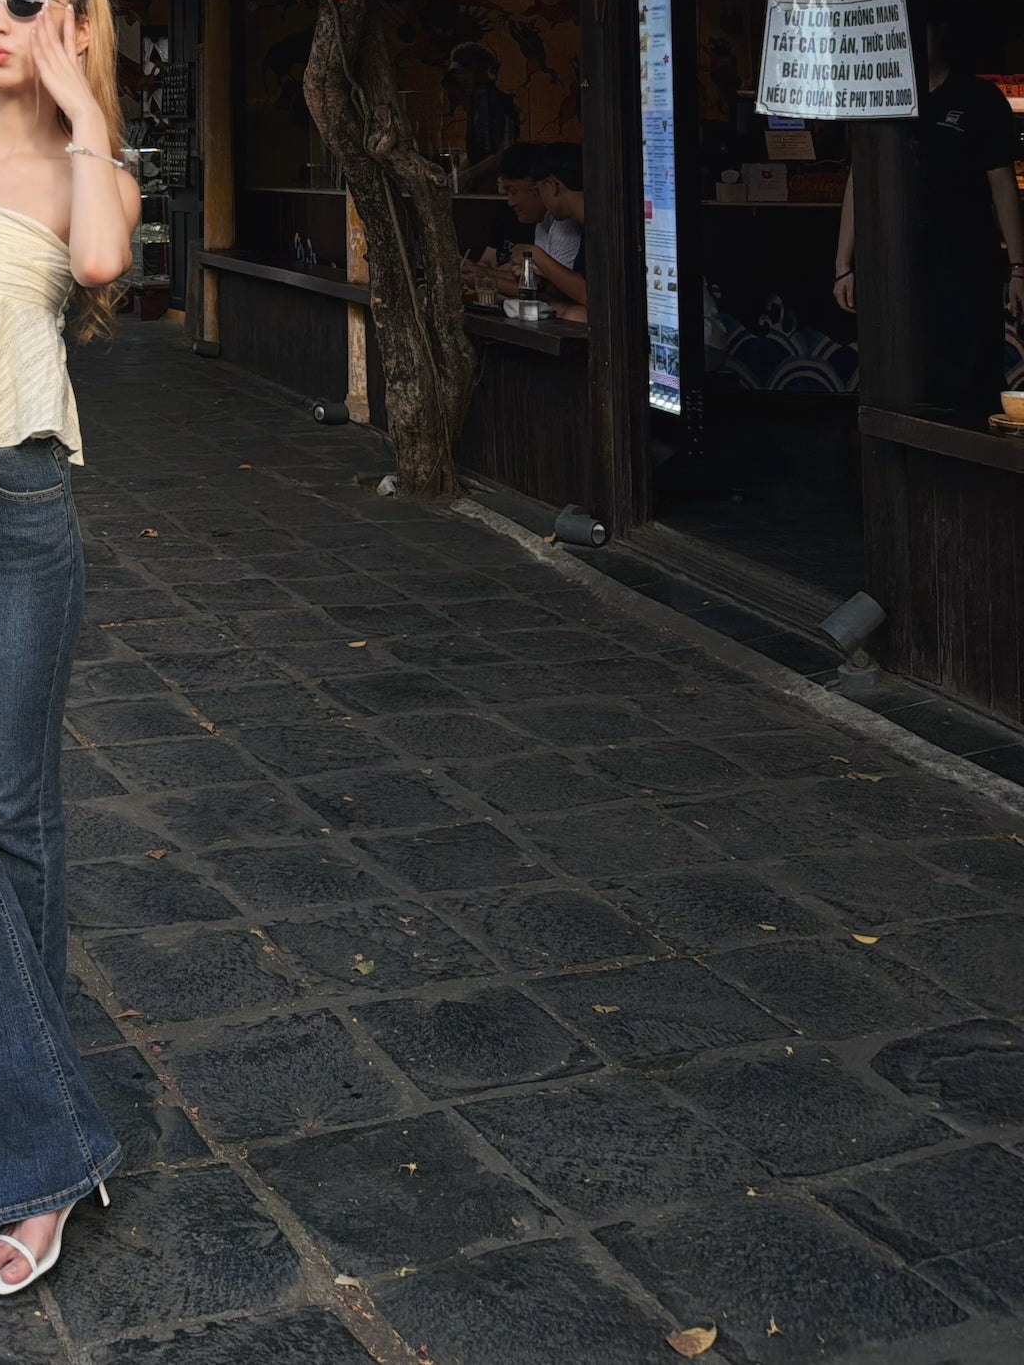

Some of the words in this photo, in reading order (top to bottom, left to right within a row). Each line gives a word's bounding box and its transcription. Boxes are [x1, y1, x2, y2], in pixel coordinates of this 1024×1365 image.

[876, 4, 900, 24] MANG
[773, 30, 796, 52] TẤT
[839, 34, 859, 55] ĂN,
[861, 31, 884, 53] THỨC
[885, 26, 907, 51] UỐNG
[782, 59, 809, 79] BÊN
[812, 60, 850, 81] NGOÀI
[853, 60, 873, 81] VÀO
[876, 57, 903, 82] QUÁN.
[766, 82, 787, 104] NẾU
[789, 85, 803, 105] CÓ
[806, 87, 833, 108] QUÁN
[835, 87, 848, 108] SẼ
[849, 90, 867, 112] PHỤ
[869, 89, 884, 108] THU
